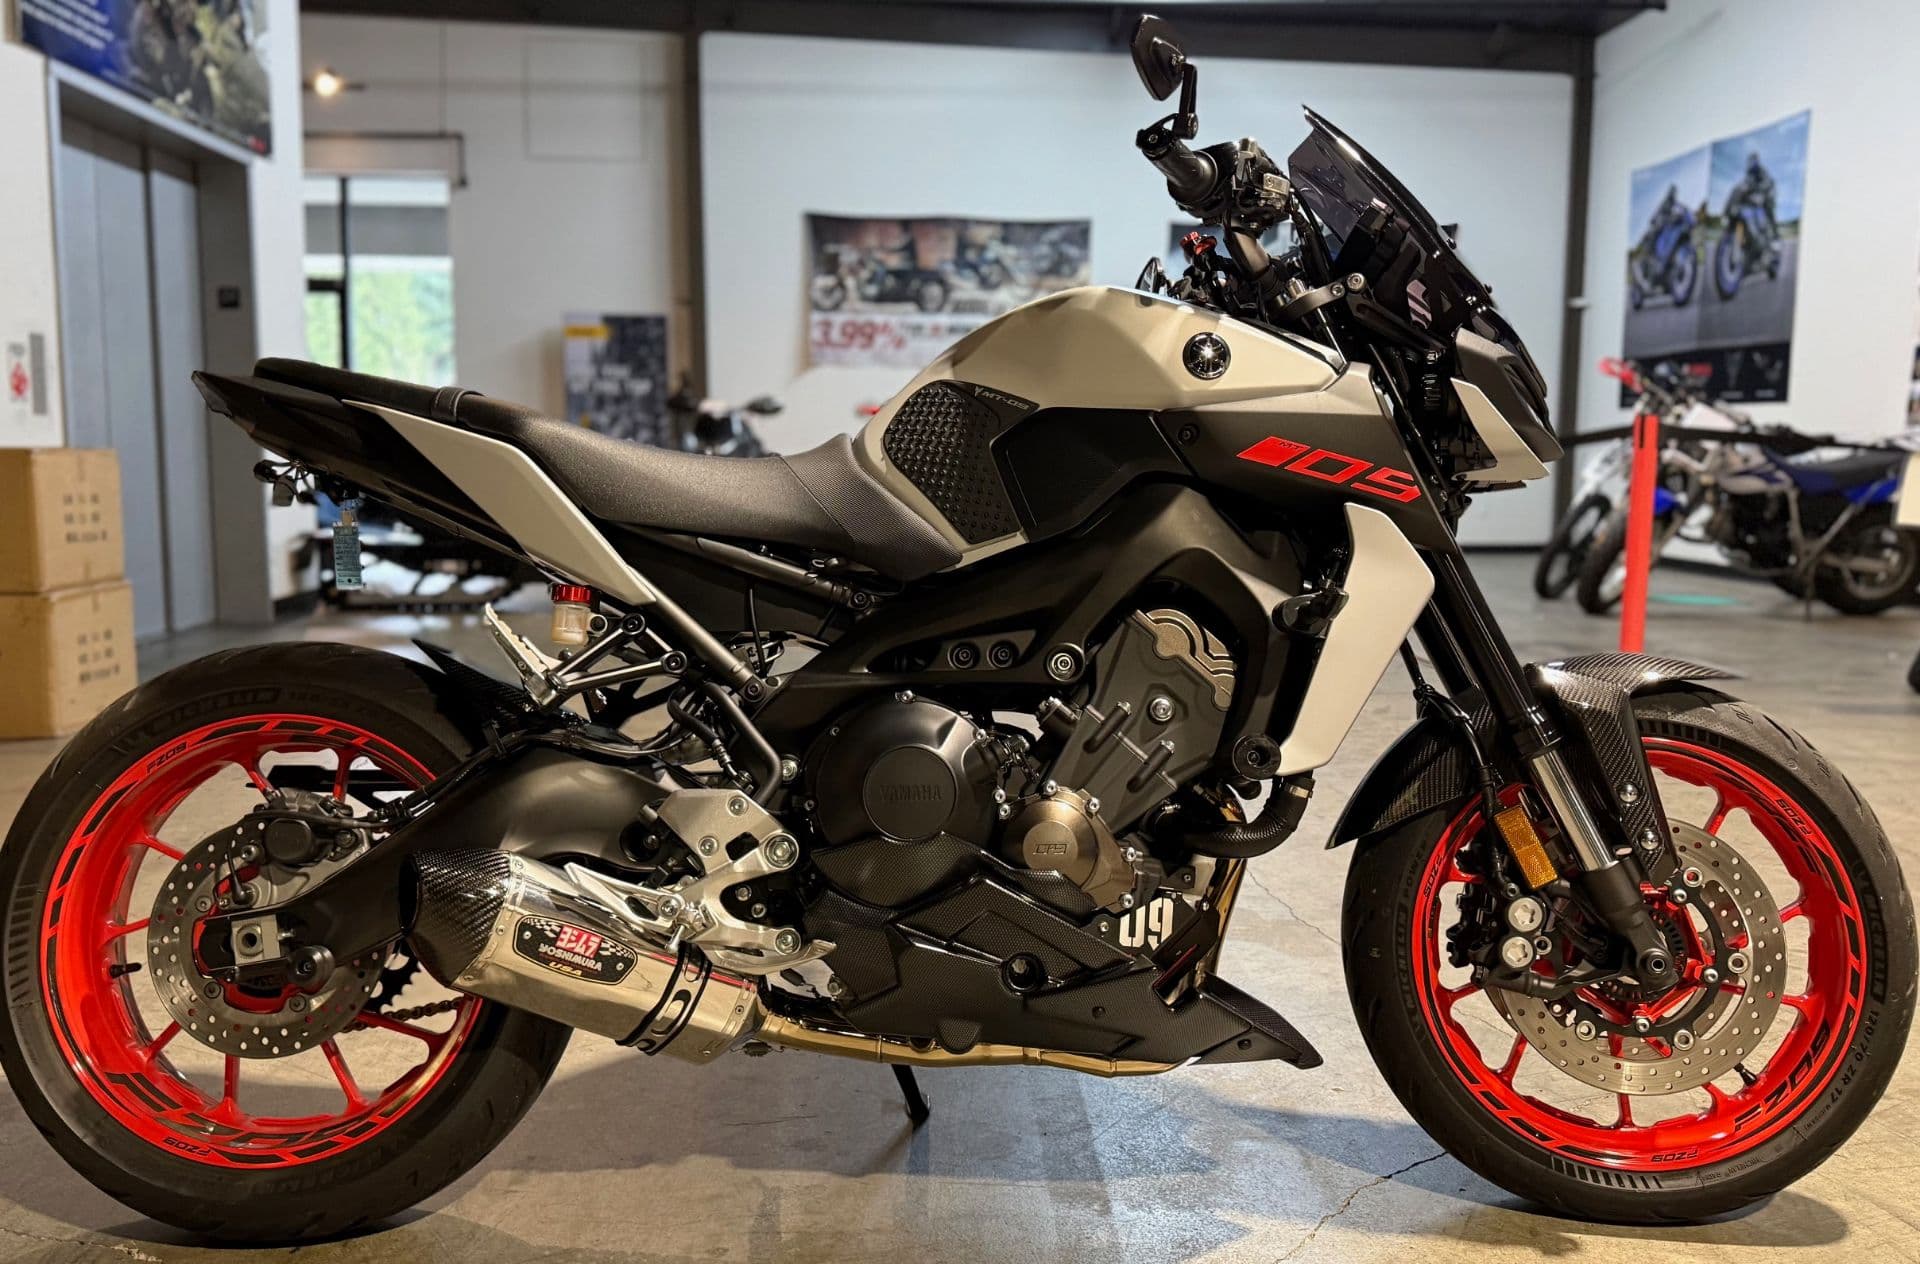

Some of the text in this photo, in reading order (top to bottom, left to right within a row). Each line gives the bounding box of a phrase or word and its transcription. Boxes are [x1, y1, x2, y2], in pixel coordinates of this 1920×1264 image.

[146, 741, 187, 774] FZ09
[880, 783, 942, 801] YAMAHA
[538, 943, 603, 972] YOSHIMURA
[548, 961, 582, 976] USA
[1855, 1009, 1880, 1062] 120/70
[1841, 1064, 1857, 1086] ZR
[1830, 1087, 1843, 1103] 17
[163, 1136, 212, 1154] FZ09
[1650, 1148, 1698, 1162] FZ09
